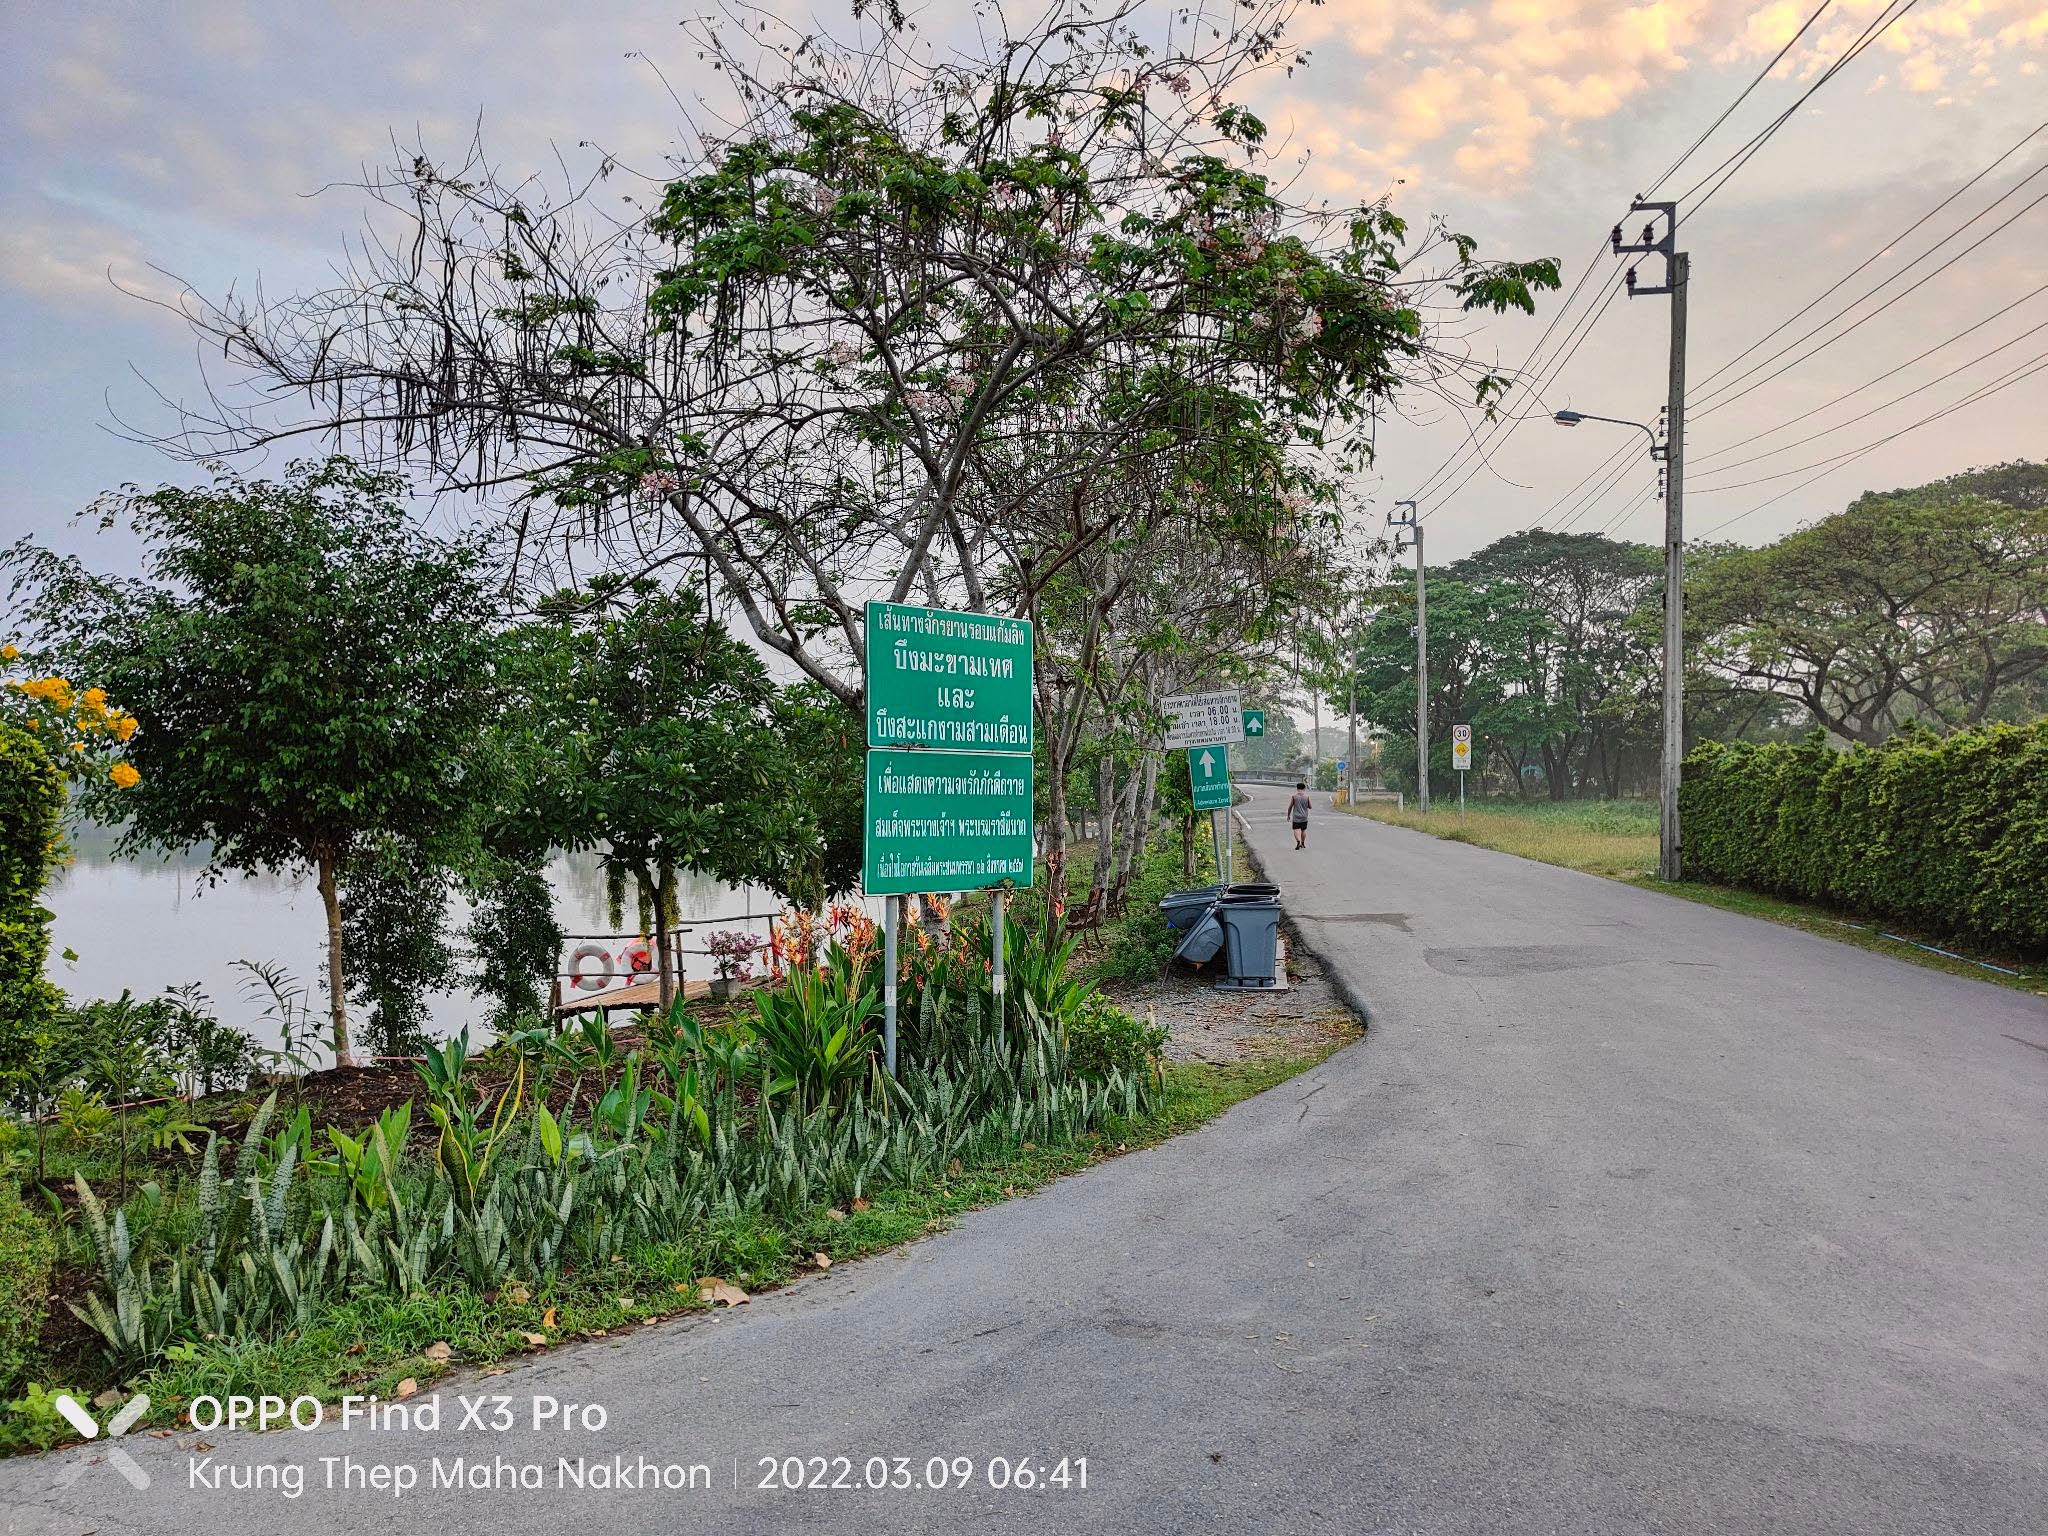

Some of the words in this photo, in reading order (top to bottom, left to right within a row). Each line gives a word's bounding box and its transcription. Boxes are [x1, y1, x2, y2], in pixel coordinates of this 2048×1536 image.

[879, 605, 1025, 645] เส้นทางจักรยานรอบแก้มลิง
[893, 639, 1014, 679] บึงมะขามเทศ
[937, 686, 975, 709] และ
[1207, 705, 1229, 716] 06.00
[876, 708, 1028, 744] บึงสะแกงามสามเดือน
[1209, 715, 1230, 726] 18.00
[878, 761, 1025, 796] เพื่อแสดงความจงรักภักดีถวาย
[875, 810, 955, 838] สมเด็จพระนางเจ้าฯ
